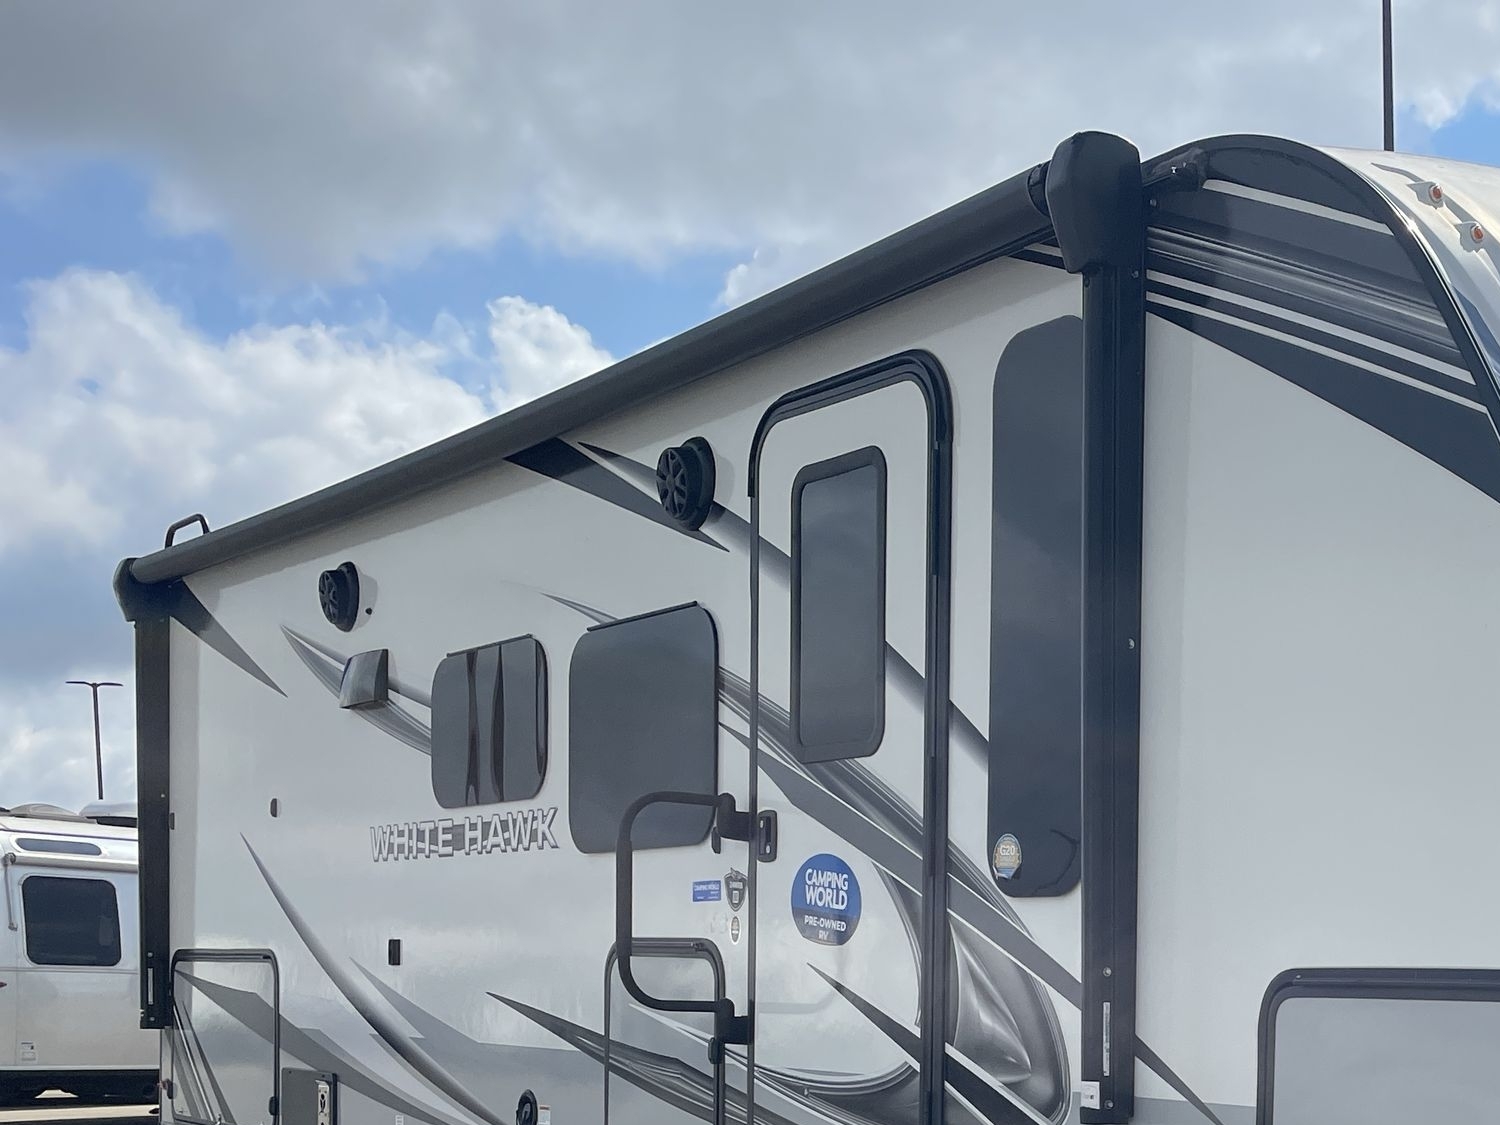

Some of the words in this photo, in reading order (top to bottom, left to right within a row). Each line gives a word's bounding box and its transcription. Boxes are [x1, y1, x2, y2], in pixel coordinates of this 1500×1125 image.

[370, 818, 454, 862] WHITE
[464, 807, 560, 856] HAWK
[1000, 845, 1016, 856] G20
[805, 868, 849, 891] CAMPING
[805, 884, 848, 911] WORLD
[804, 915, 847, 932] PRE-OWNED
[819, 930, 829, 940] RV
